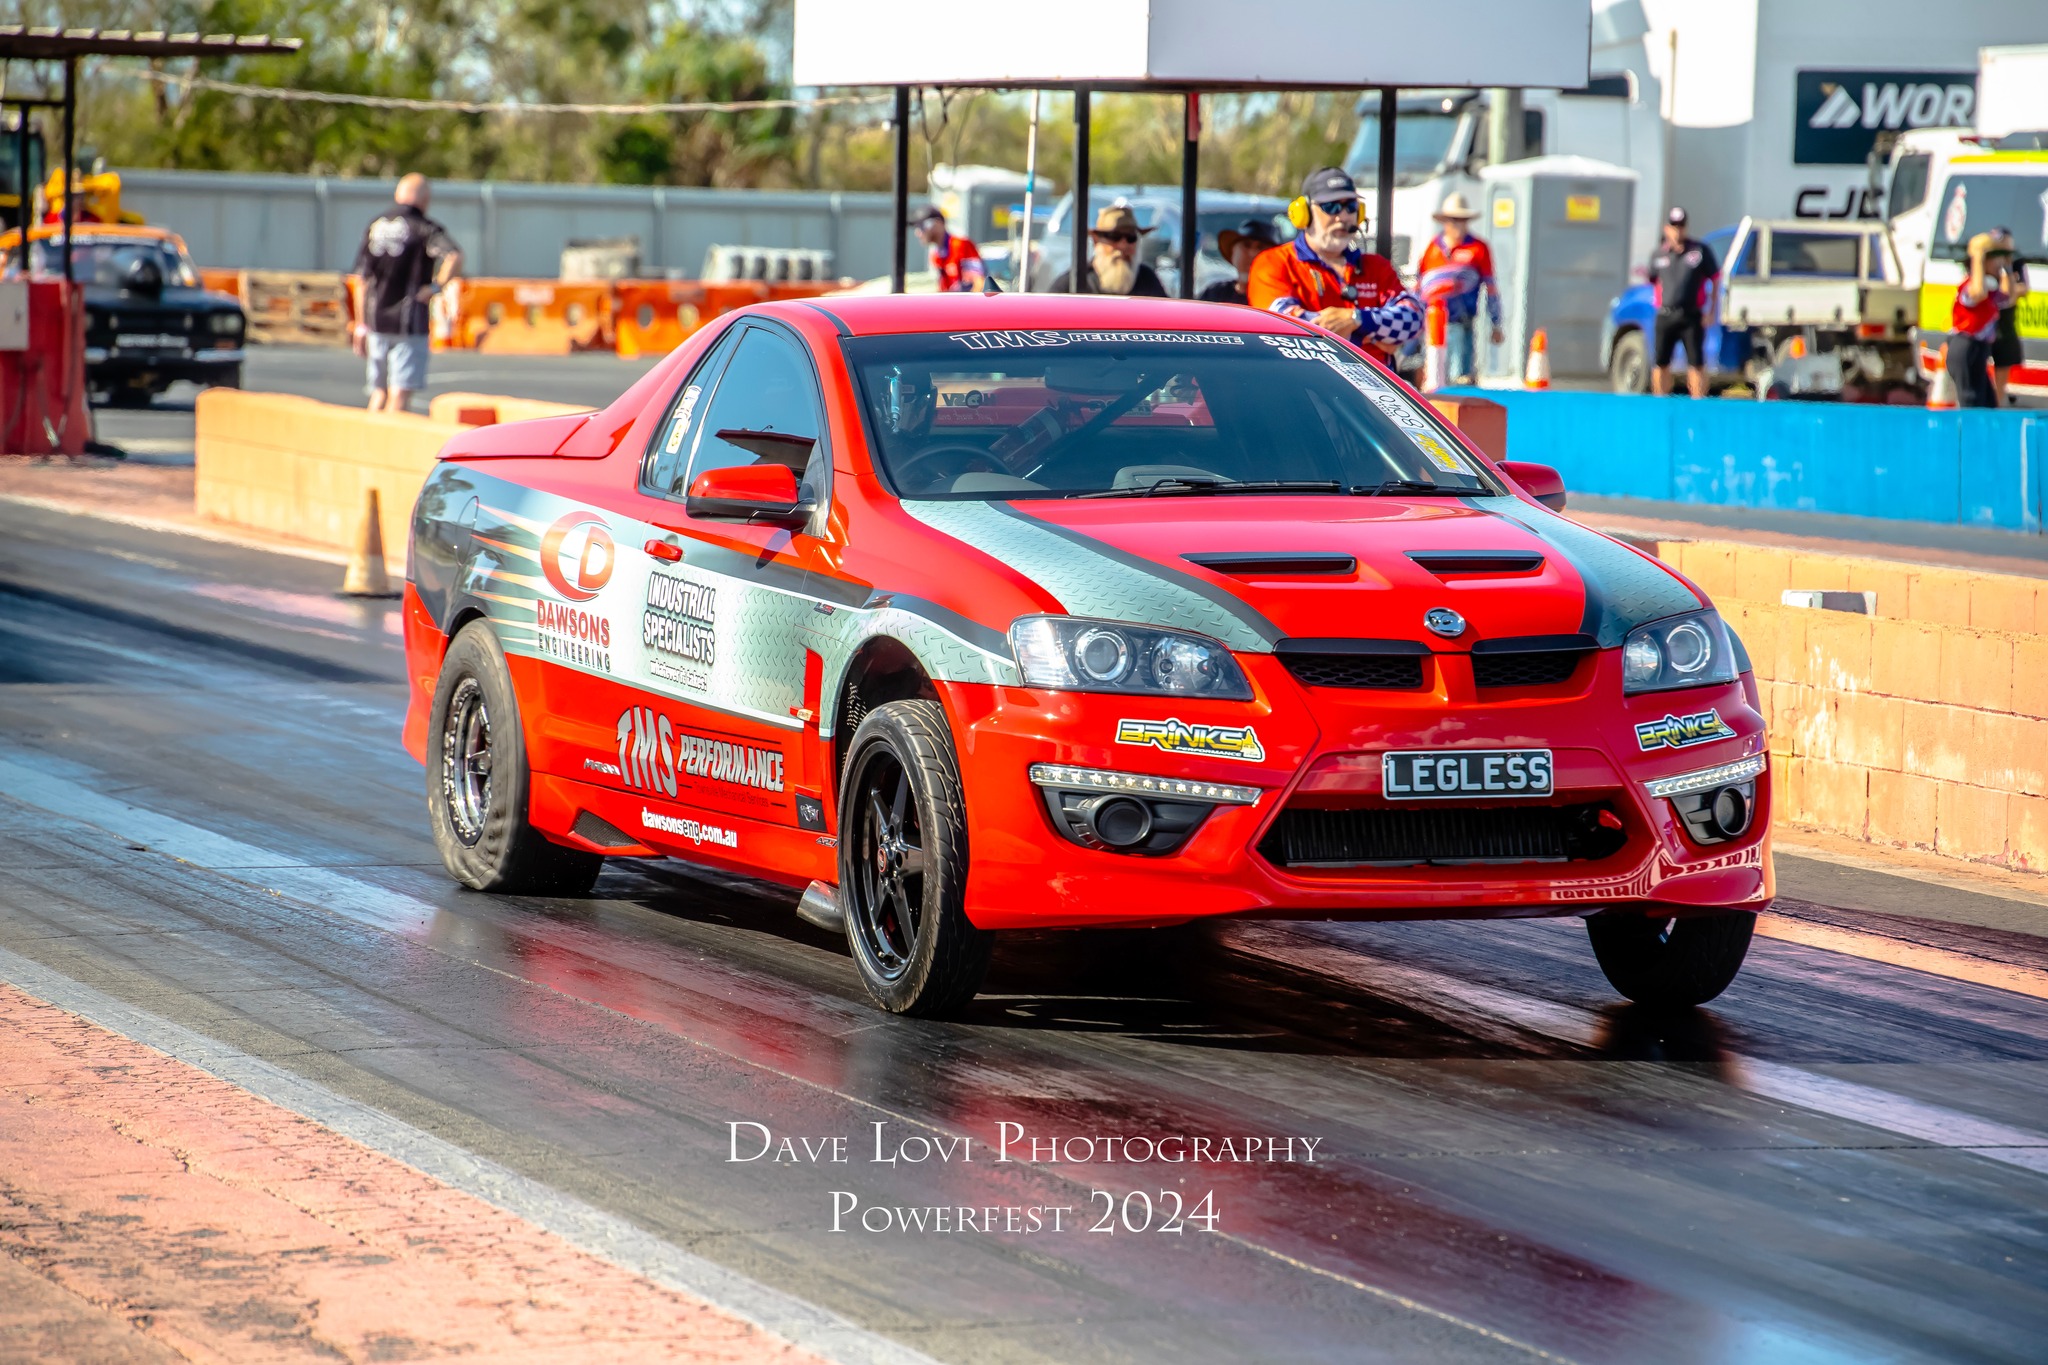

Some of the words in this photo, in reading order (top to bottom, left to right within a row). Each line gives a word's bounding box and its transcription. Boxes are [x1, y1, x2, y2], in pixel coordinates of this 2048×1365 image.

[1861, 82, 1976, 129] WOR
[950, 330, 1070, 350] TMS
[1068, 333, 1245, 345] PERFORMANCE
[1259, 335, 1338, 354] SS/AA
[1278, 346, 1342, 363] 8040
[648, 571, 716, 625] INDUSTRIAL
[537, 599, 611, 648] DAWSONS
[643, 609, 715, 666] SPECIALISTS
[538, 632, 611, 673] ENGINEERING
[1120, 721, 1244, 751] BRiNKS
[1638, 715, 1719, 746] BRiNKS
[616, 705, 678, 798] TMS
[677, 734, 785, 793] PERFORMANCE
[1176, 746, 1242, 757] PERFORMANCE
[1387, 756, 1550, 792] LEGLESS
[641, 806, 738, 848] dawsonseng.com.au
